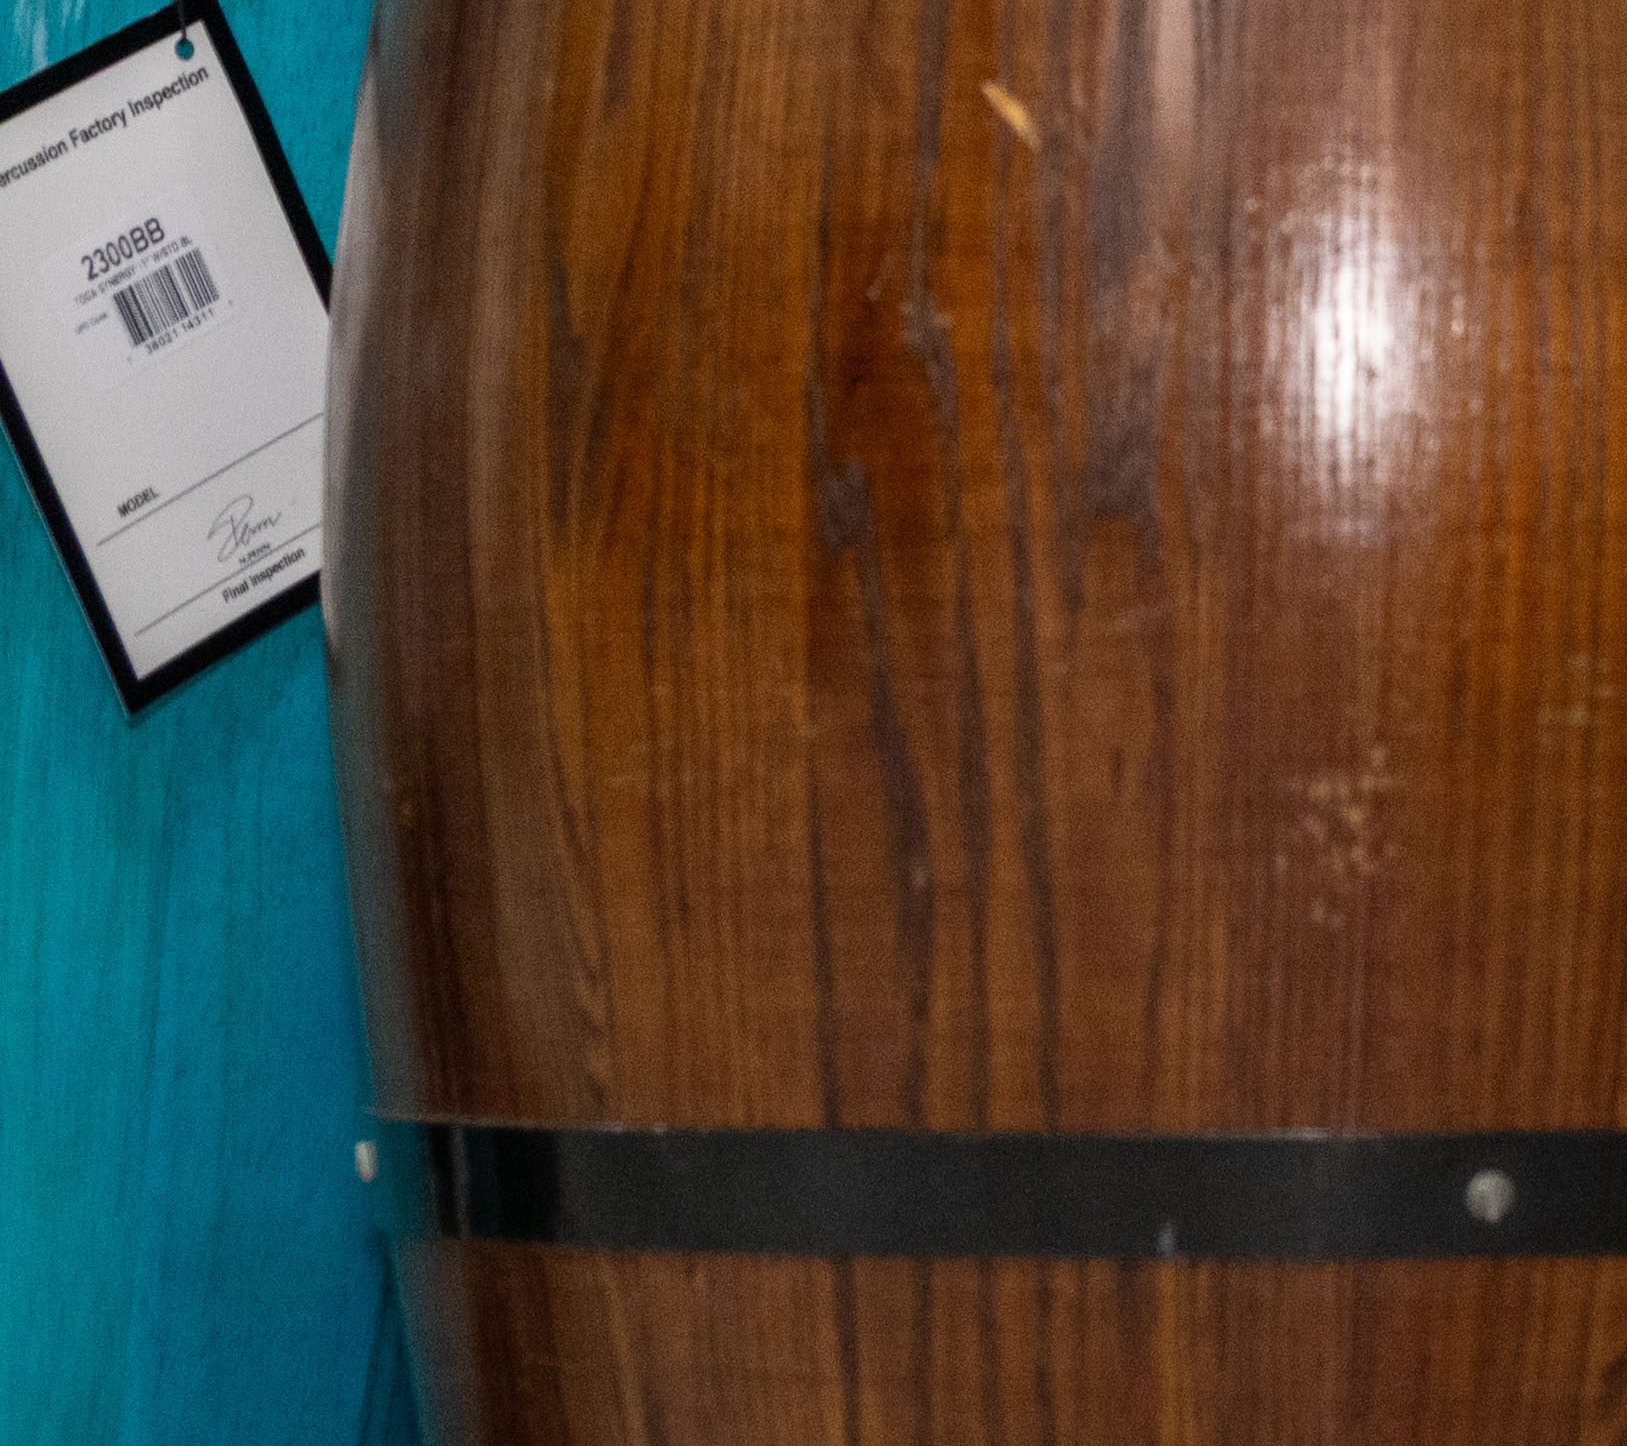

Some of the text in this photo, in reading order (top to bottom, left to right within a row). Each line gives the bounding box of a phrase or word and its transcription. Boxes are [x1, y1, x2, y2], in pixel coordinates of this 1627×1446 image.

[0, 65, 210, 189] ercussion Factory Inspection
[81, 217, 165, 282] 2300BB
[116, 486, 160, 518] MODEL
[222, 579, 249, 604] Final
